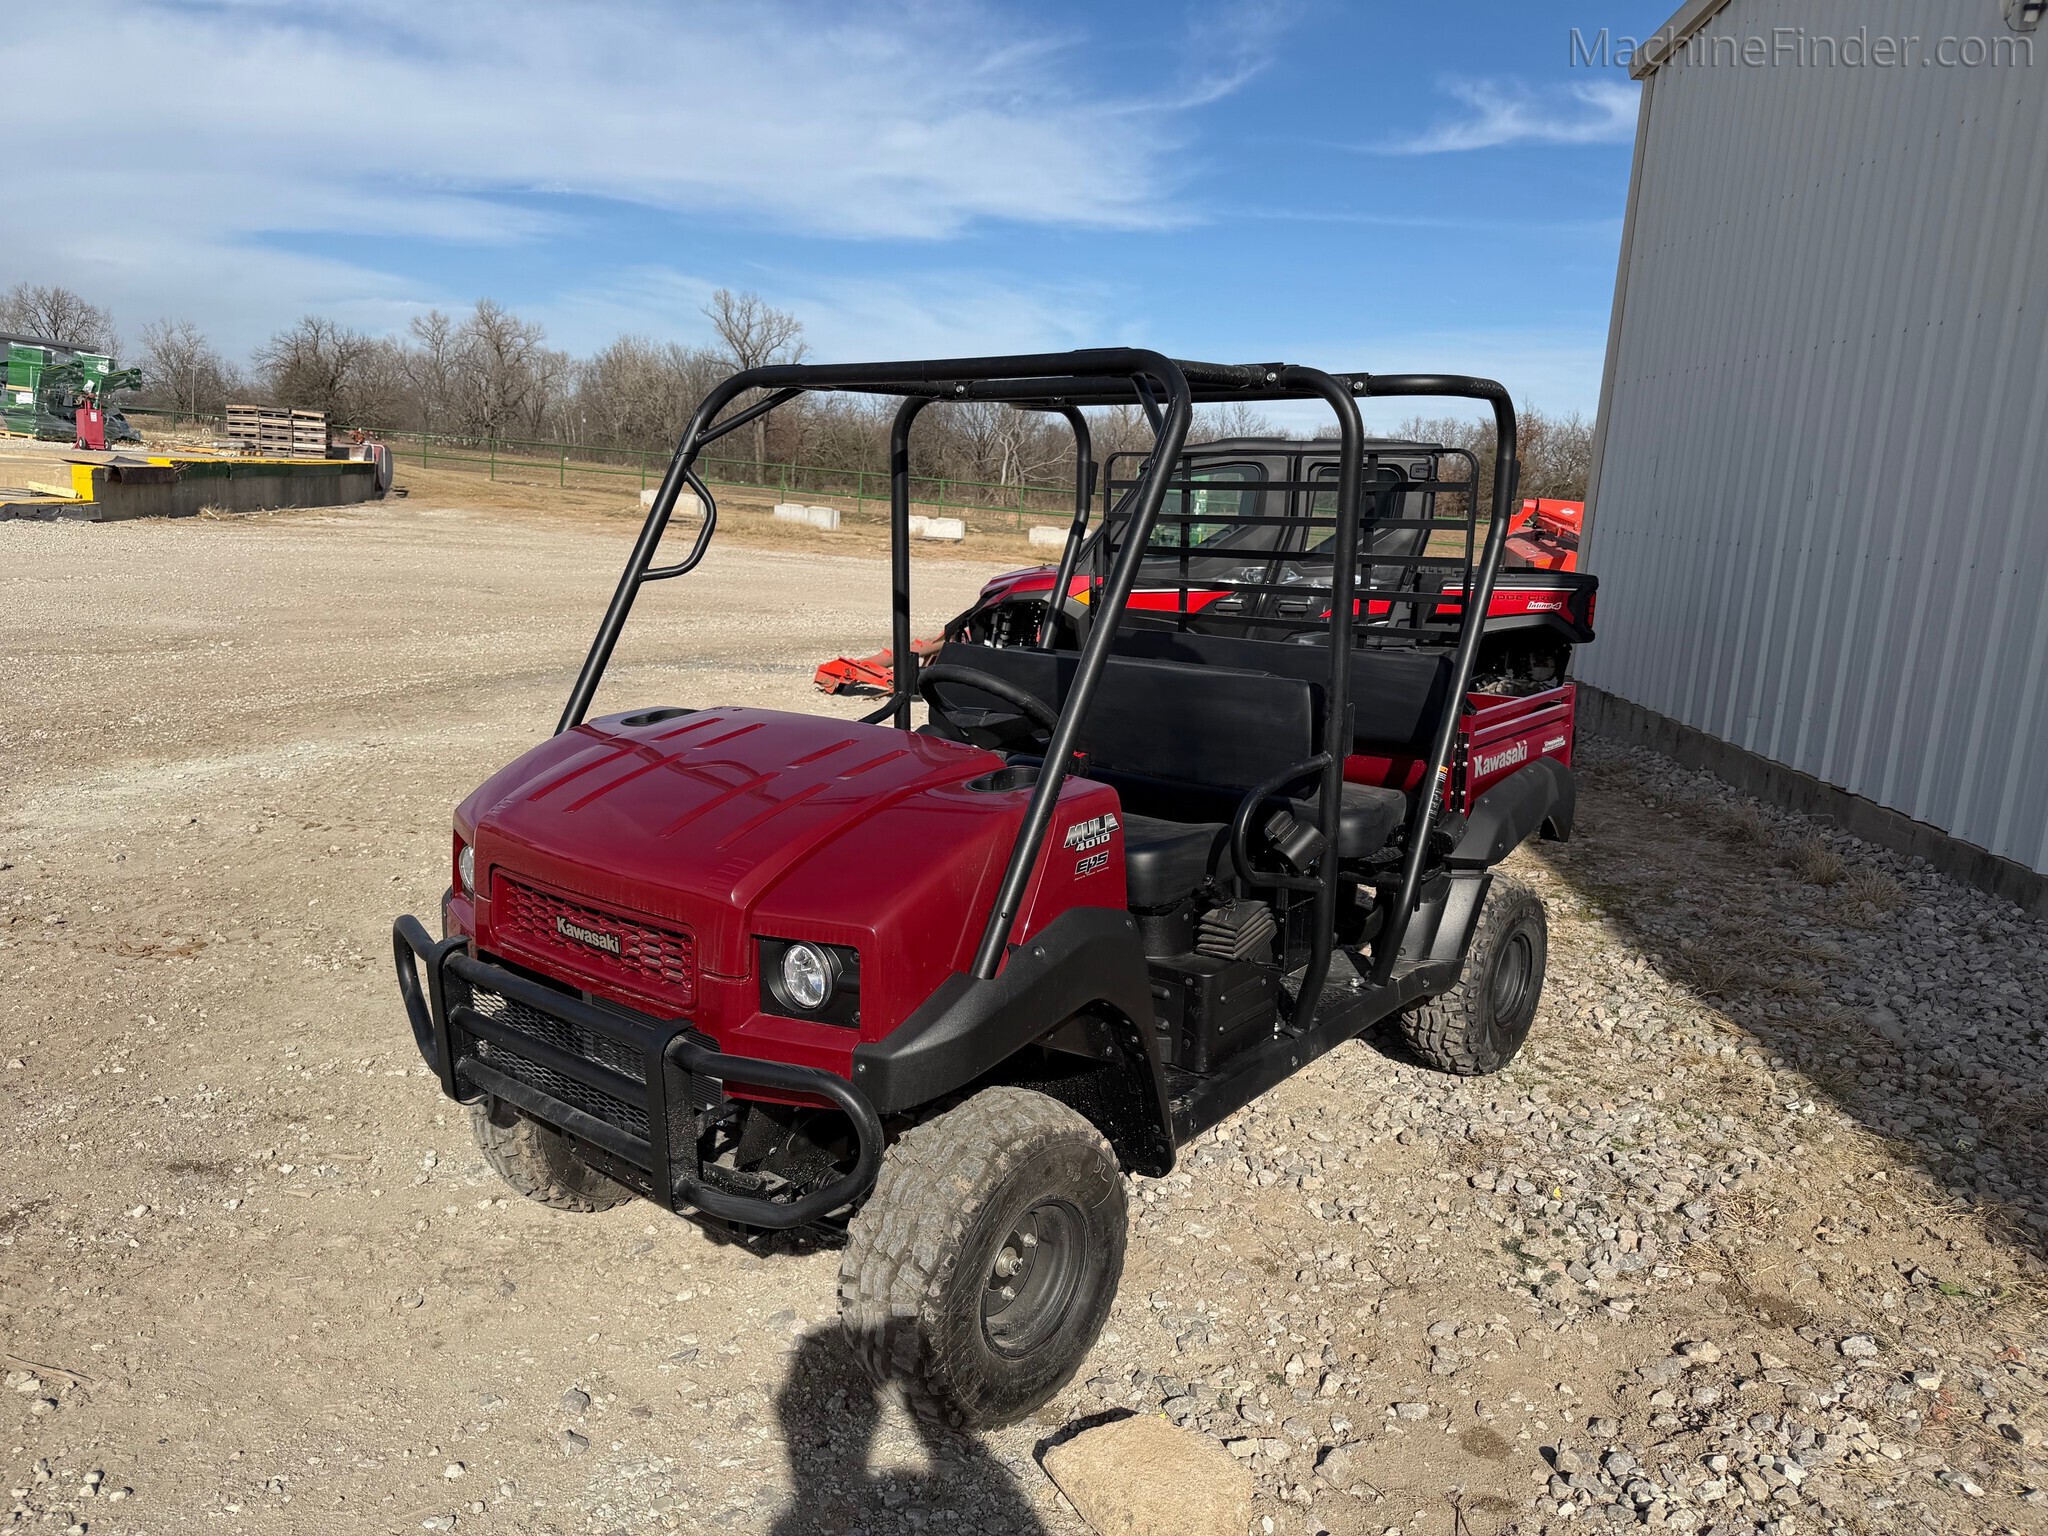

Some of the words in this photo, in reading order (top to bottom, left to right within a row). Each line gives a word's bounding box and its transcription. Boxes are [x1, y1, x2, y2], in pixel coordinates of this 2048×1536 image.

[1473, 740, 1528, 778] Kawasaki
[1063, 812, 1120, 849] MULE
[1075, 833, 1111, 852] 4010
[1074, 850, 1110, 875] EPS
[556, 916, 620, 954] Kawasaki
